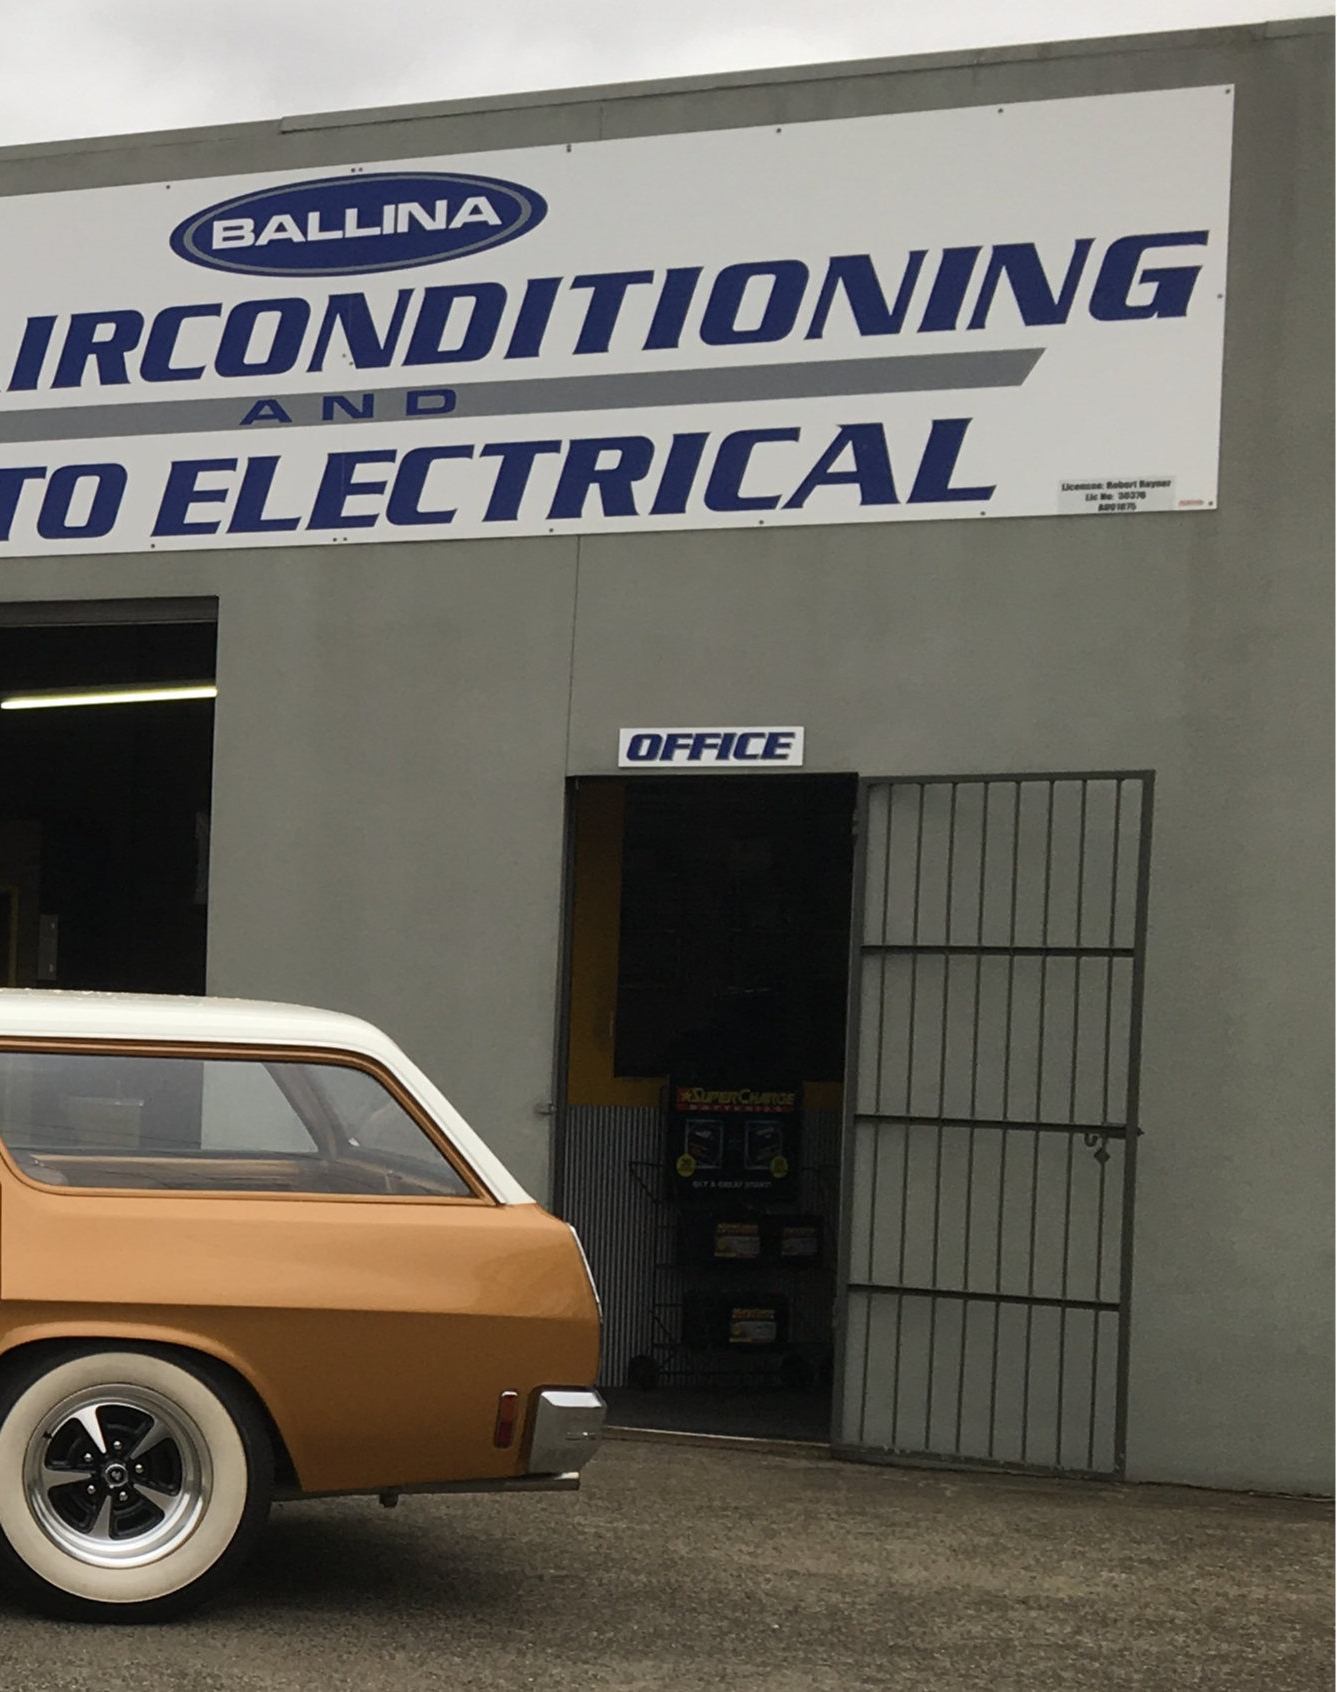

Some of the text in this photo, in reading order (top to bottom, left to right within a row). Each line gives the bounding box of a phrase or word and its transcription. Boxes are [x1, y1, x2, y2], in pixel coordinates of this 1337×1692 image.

[211, 196, 503, 249] BALLINA
[241, 388, 458, 426] AND
[150, 417, 995, 536] ELECTRICAL
[626, 731, 797, 762] OFFICE
